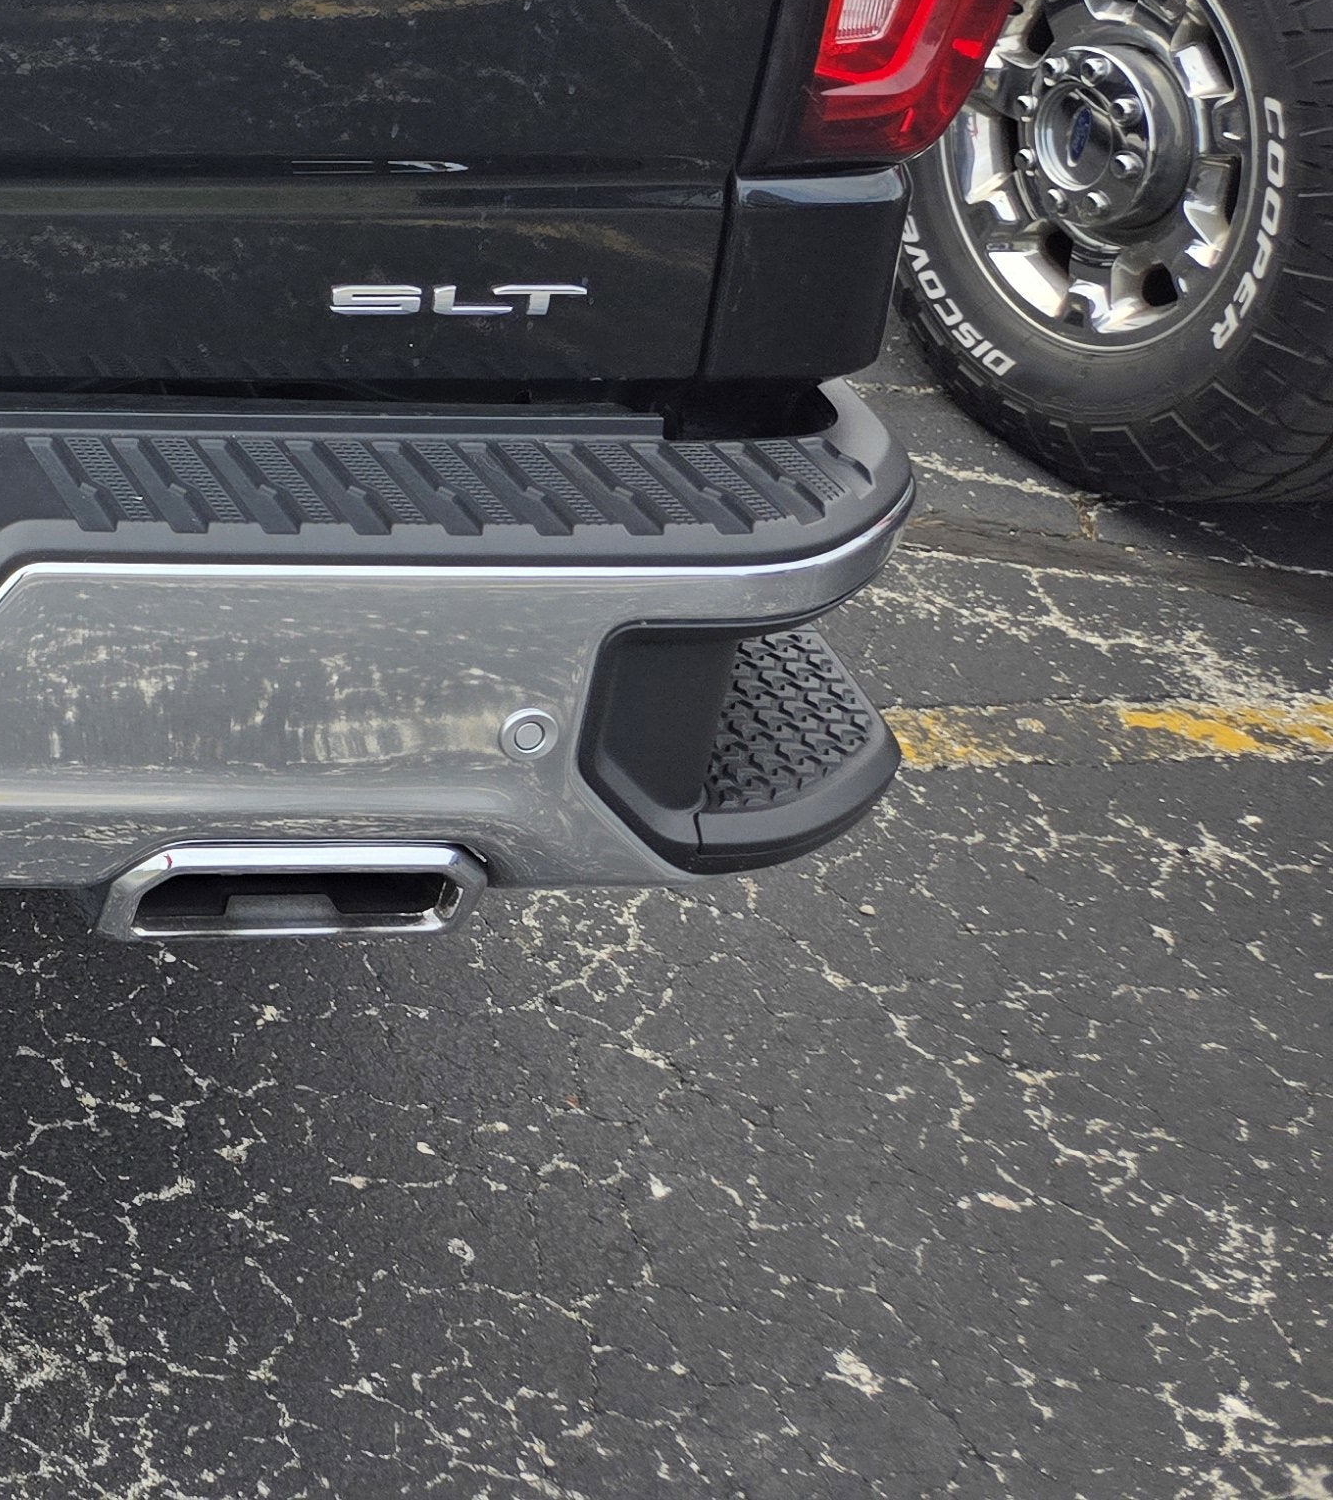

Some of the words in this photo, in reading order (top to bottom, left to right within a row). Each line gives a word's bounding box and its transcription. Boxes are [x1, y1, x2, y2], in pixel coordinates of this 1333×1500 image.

[329, 283, 588, 316] SLT
[901, 214, 1018, 377] DISCOVE
[1209, 96, 1286, 350] COOPER
